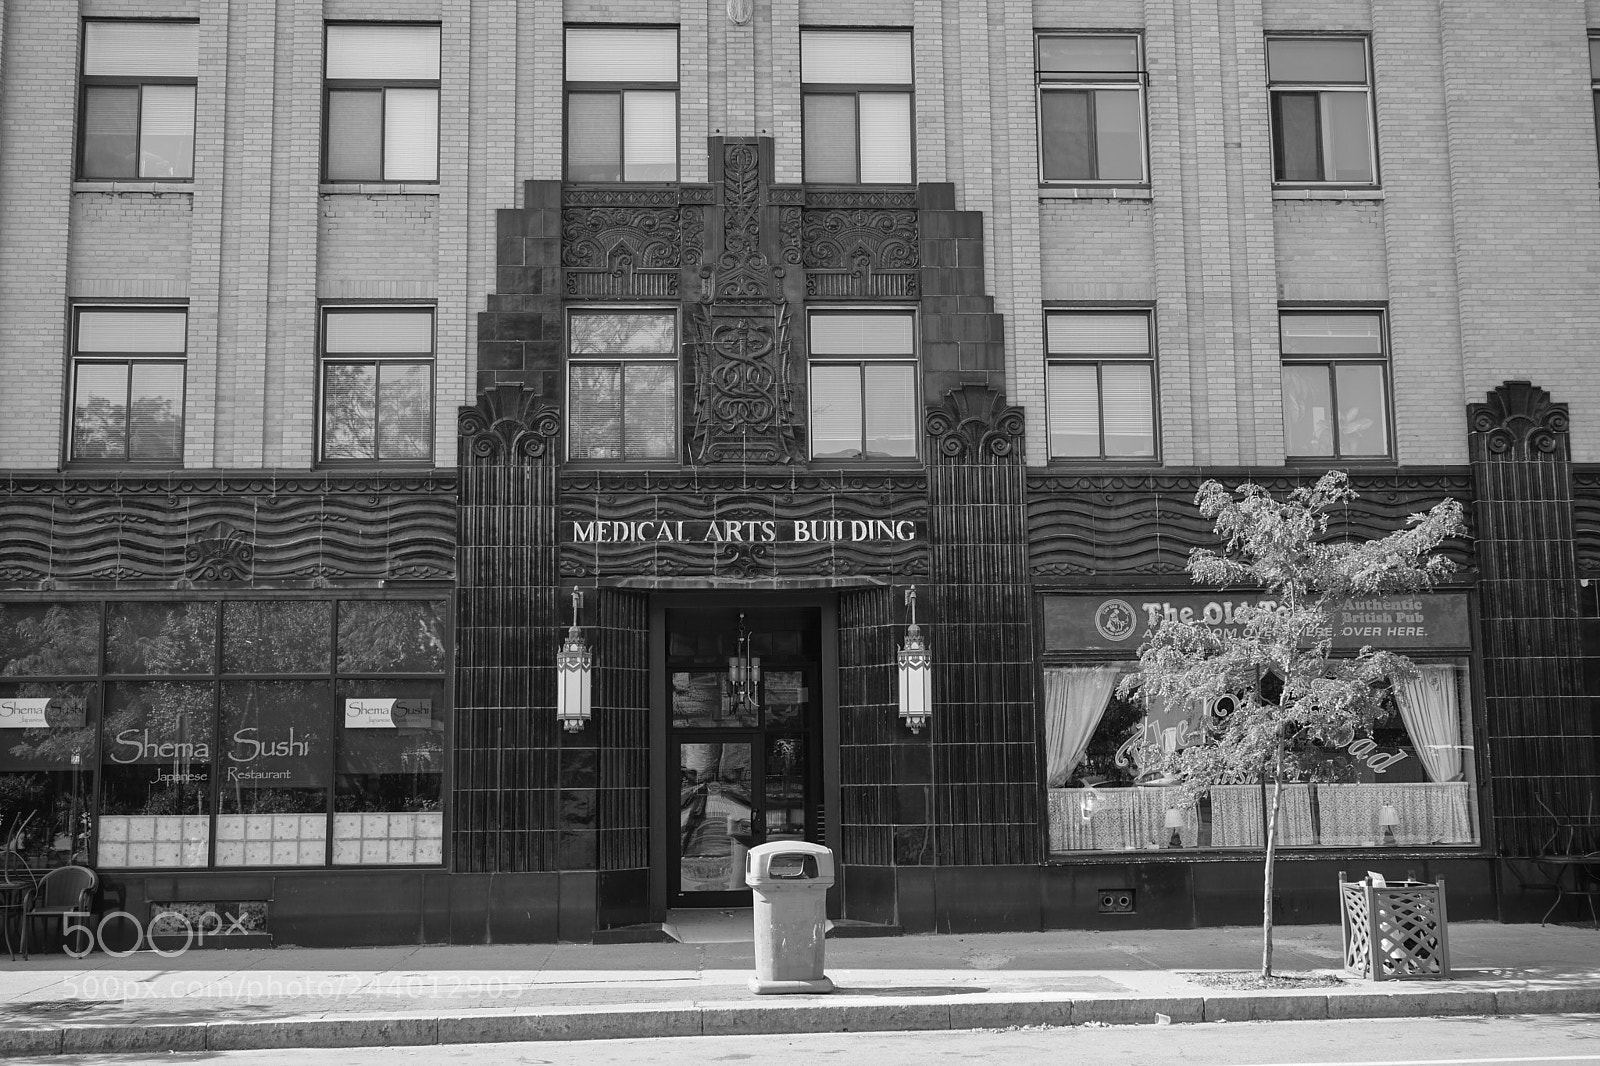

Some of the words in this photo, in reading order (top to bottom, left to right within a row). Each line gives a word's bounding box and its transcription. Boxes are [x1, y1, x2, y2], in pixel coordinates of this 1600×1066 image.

[573, 520, 690, 542] MEDICAL
[704, 520, 776, 542] ARTS
[794, 520, 915, 542] BUILDING
[1342, 599, 1423, 611] Authentic
[1142, 602, 1194, 625] The
[1342, 612, 1393, 623] British
[1396, 612, 1425, 623] Pub
[1342, 626, 1382, 637] OVER
[1387, 626, 1429, 637] HERE.
[0, 701, 43, 717] Shema
[346, 701, 390, 717] Shema
[394, 701, 429, 717] Sushi
[110, 728, 209, 764] Shema
[228, 727, 309, 762] Sushi
[150, 767, 208, 786] Japanese
[227, 766, 292, 782] Restaurant
